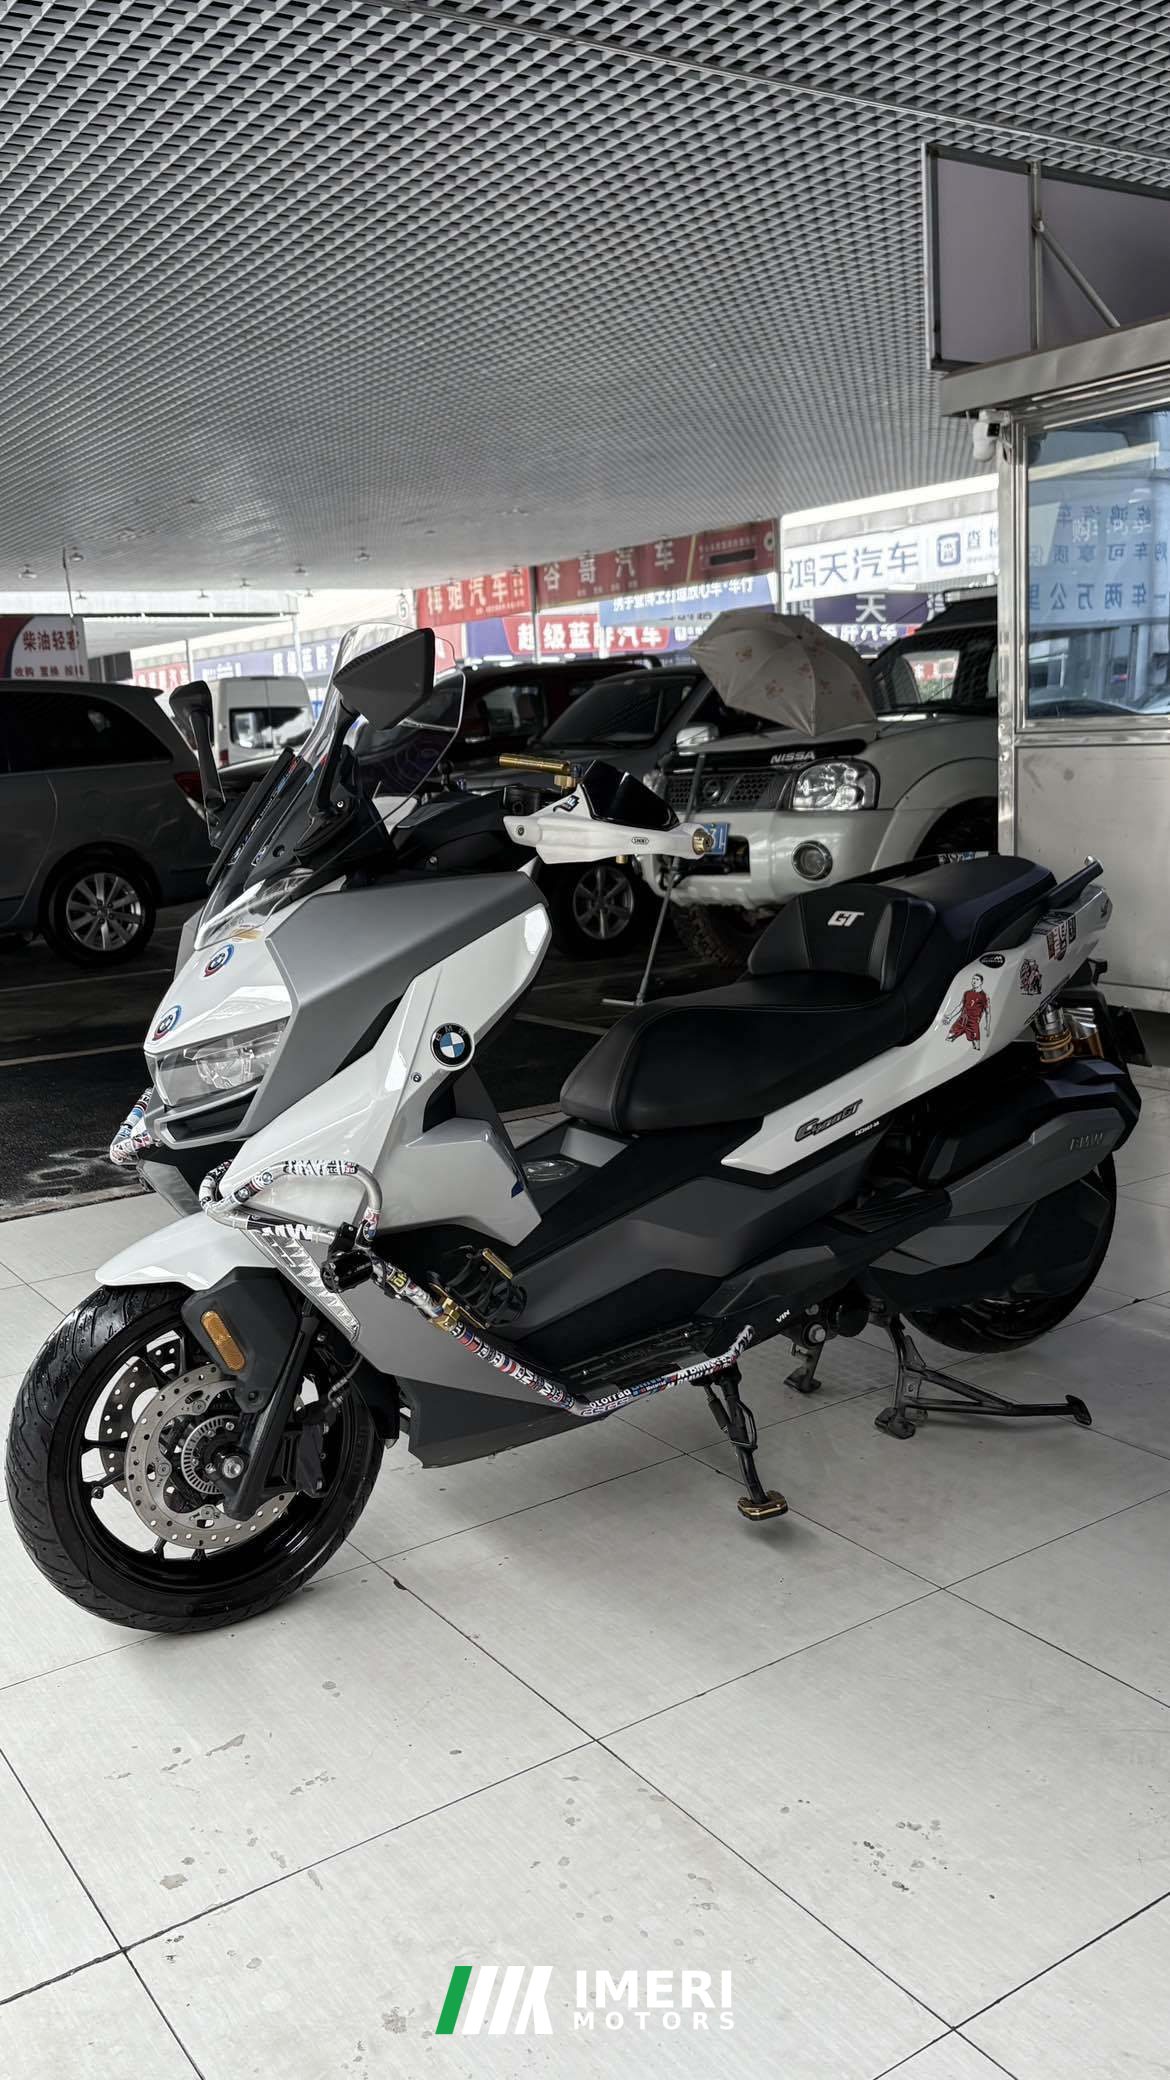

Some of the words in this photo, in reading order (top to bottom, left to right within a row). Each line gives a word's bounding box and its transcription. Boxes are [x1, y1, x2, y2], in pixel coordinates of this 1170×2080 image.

[788, 541, 919, 590] 鸿天汽车
[827, 910, 865, 927] GT
